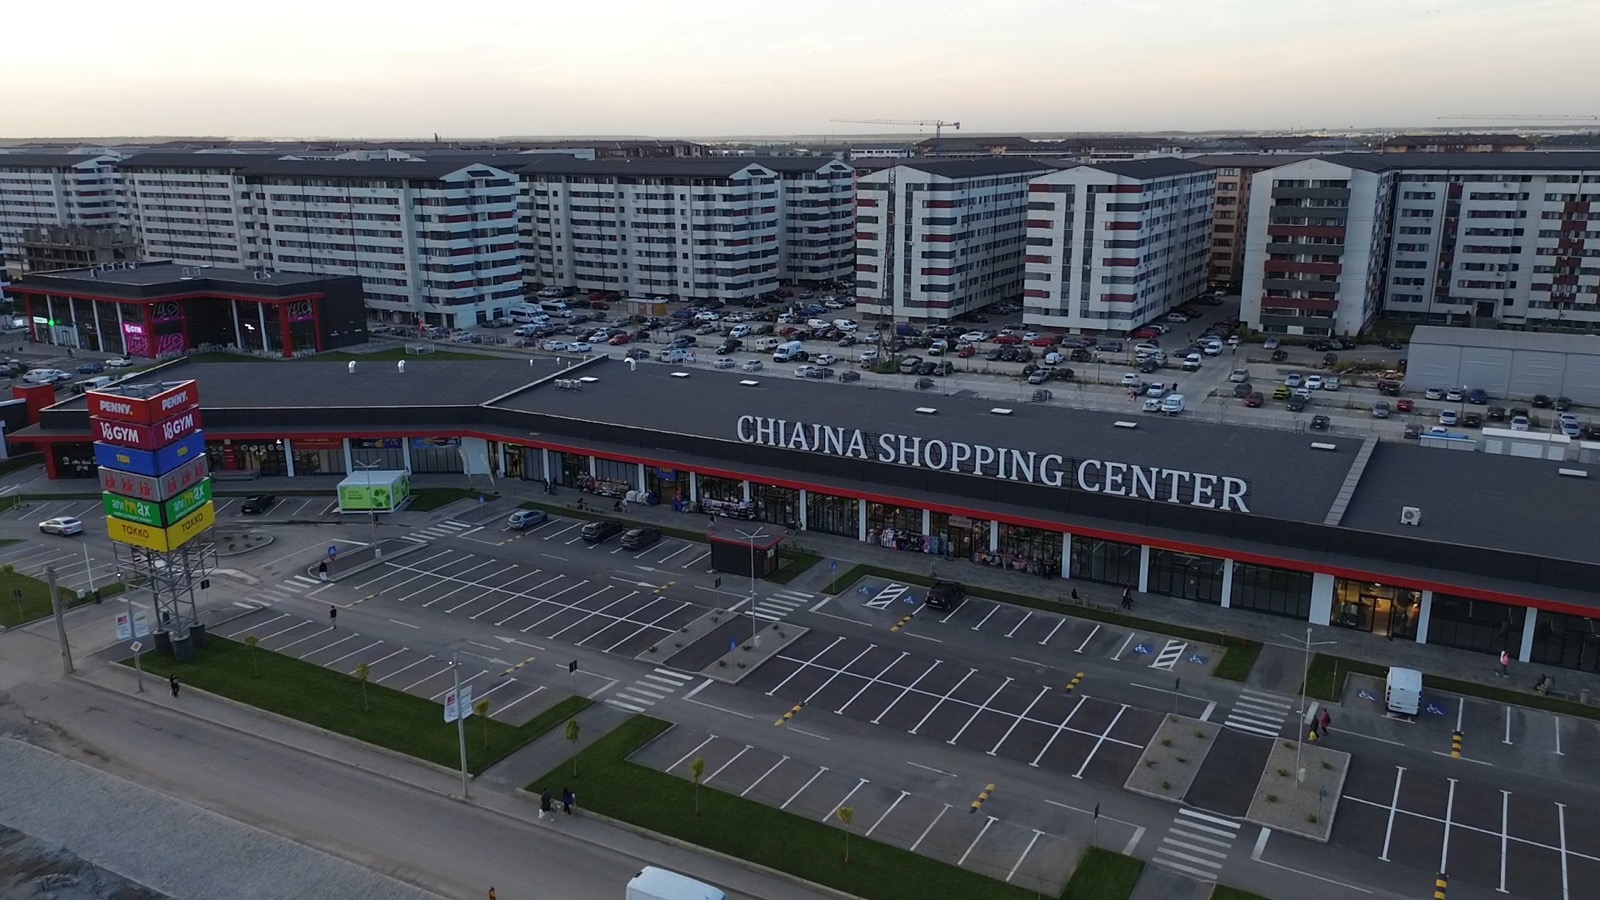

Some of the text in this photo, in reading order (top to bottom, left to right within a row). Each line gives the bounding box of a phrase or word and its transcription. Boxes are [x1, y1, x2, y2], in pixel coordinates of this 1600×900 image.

[737, 415, 1250, 513] CHIAJNA SHOPPING CENTER
